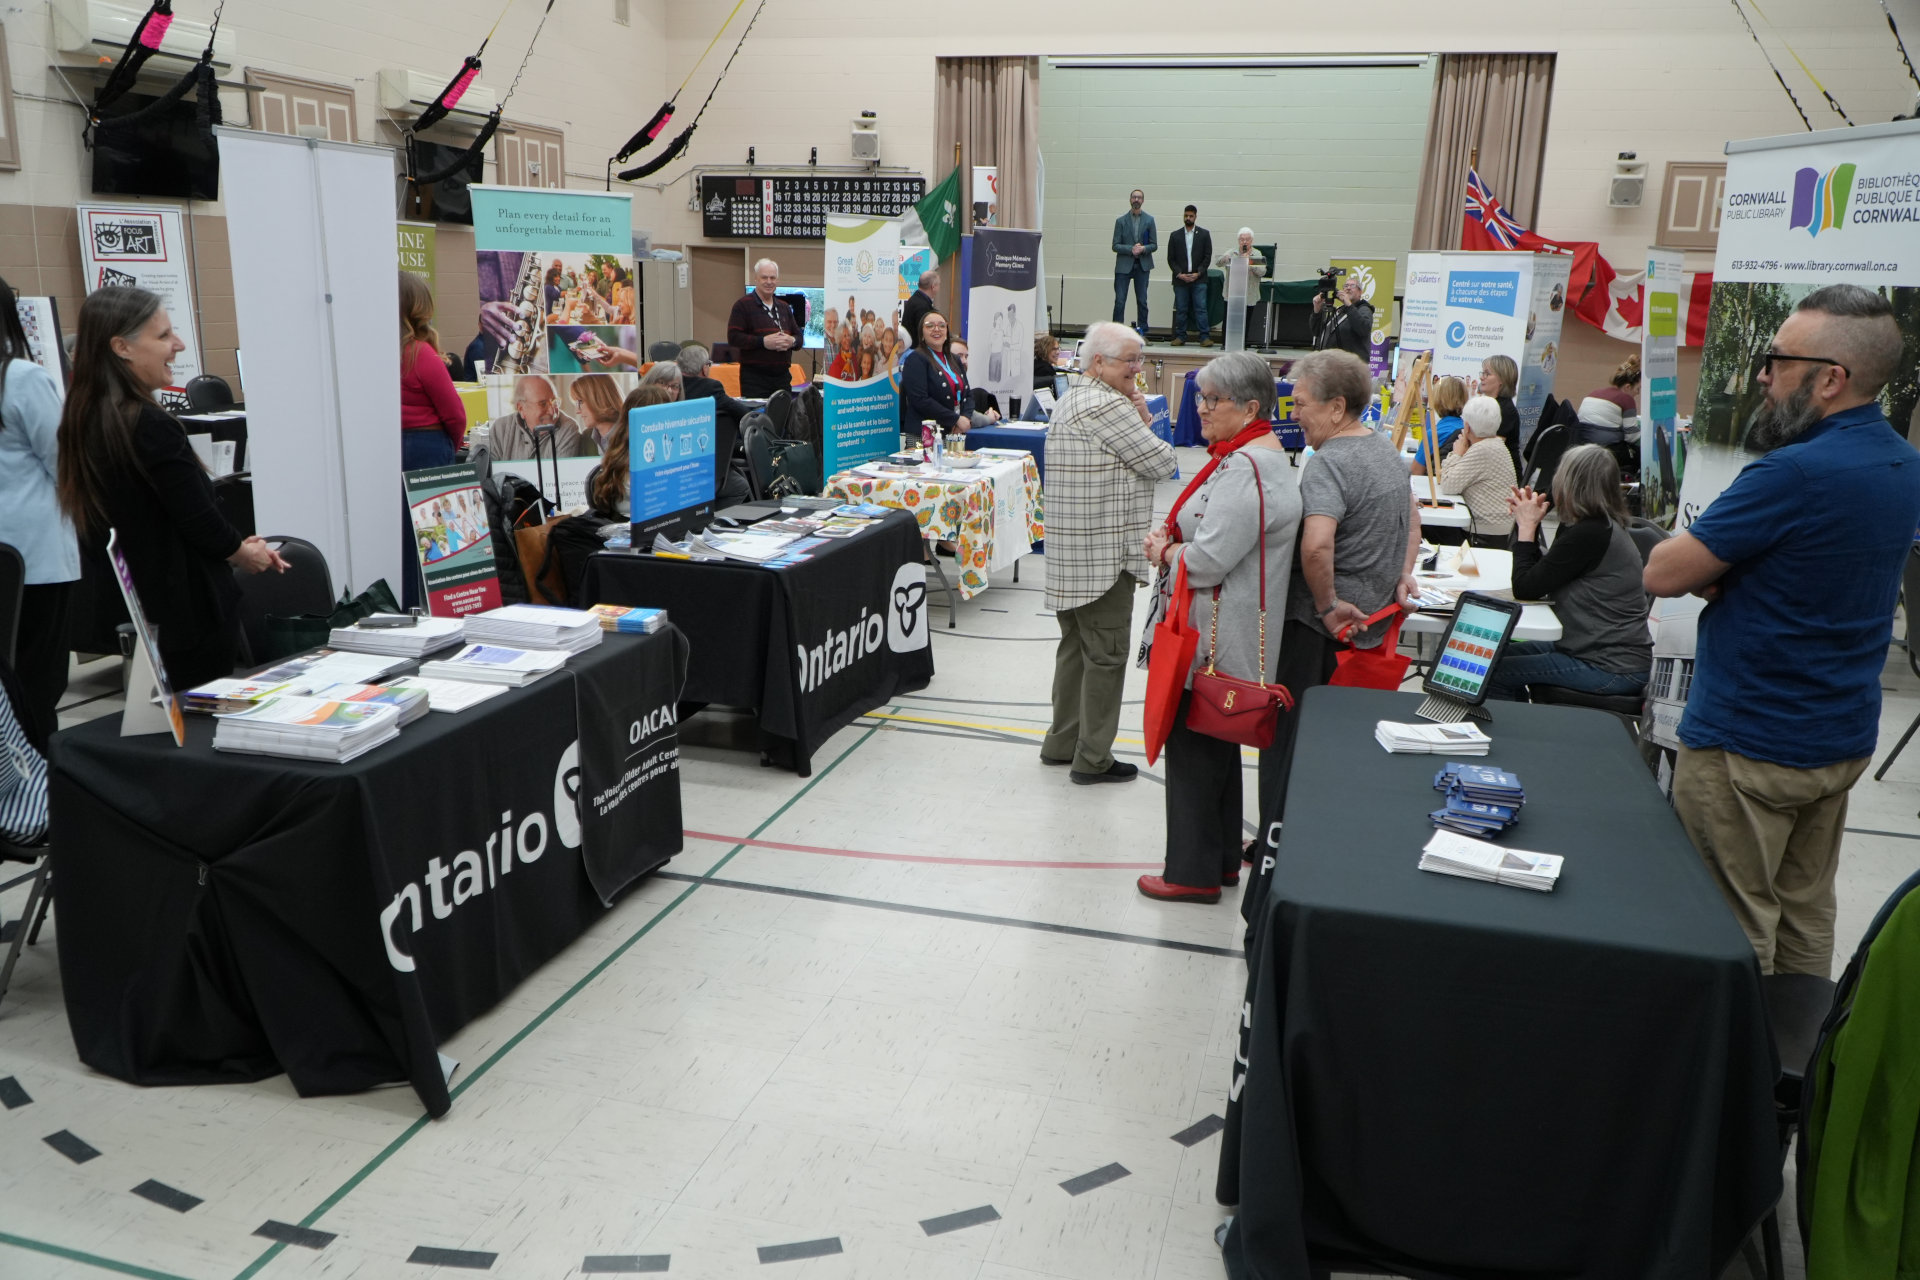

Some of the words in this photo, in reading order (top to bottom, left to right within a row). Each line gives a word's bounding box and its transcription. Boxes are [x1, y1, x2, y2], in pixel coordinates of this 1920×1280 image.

[776, 181, 779, 189] 1
[785, 181, 789, 190] 2
[795, 181, 799, 190] 3
[804, 181, 809, 190] 4
[814, 181, 818, 190] 5
[823, 181, 828, 190] 6
[834, 181, 838, 190] 7
[844, 181, 849, 190] 8
[854, 181, 859, 191] 9
[863, 182, 870, 191] 10
[873, 182, 880, 191] 11
[883, 182, 890, 191] 12
[893, 182, 900, 191] 13
[902, 182, 910, 191] 14
[912, 182, 920, 191] 15
[1857, 172, 1920, 190] BIBLIOTHÈQ
[774, 192, 782, 201] 16
[784, 192, 791, 201] 17
[793, 192, 801, 201] 18
[803, 192, 810, 201] 19
[812, 192, 820, 202] 20
[822, 192, 830, 202] 21
[831, 193, 840, 202] 22
[842, 192, 851, 202] 23
[852, 192, 861, 202] 24
[862, 193, 871, 202] 25
[872, 193, 881, 202] 26
[882, 193, 890, 202] 27
[892, 193, 901, 203] 28
[902, 193, 910, 203] 29
[912, 193, 920, 203] 30
[1729, 191, 1786, 206] CORNWALL
[1855, 190, 1913, 205] PUBLIQUE
[774, 203, 782, 212] 31
[783, 203, 792, 213] 32
[793, 203, 801, 213] 33
[802, 203, 811, 213] 34
[812, 204, 821, 213] 35
[822, 204, 830, 213] 36
[831, 204, 840, 213] 37
[842, 204, 851, 213] 38
[852, 204, 861, 213] 39
[862, 204, 871, 214] 40
[872, 205, 880, 213] 41
[882, 204, 890, 214] 42
[892, 205, 901, 214] 43
[1727, 209, 1751, 220] PUBLIC
[1752, 208, 1786, 219] LIBRARY
[498, 208, 521, 219] Plan
[523, 212, 549, 223] every
[552, 211, 579, 222] detail
[582, 212, 597, 223] for
[774, 214, 782, 224] 46
[783, 215, 792, 223] 47
[793, 215, 801, 224] 48
[802, 215, 811, 224] 49
[812, 215, 821, 224] 50
[1853, 208, 1920, 224] CORNWAL
[495, 224, 562, 237] unforgettable
[565, 228, 615, 238] memorial.
[774, 226, 782, 235] 61
[783, 226, 792, 235] 62
[793, 226, 801, 235] 63
[802, 226, 811, 235] 64
[812, 226, 821, 236] 65
[126, 235, 153, 254] ART
[398, 231, 425, 249] INE
[399, 251, 426, 267] USE
[837, 256, 854, 266] Great
[877, 257, 895, 267] Grand
[995, 254, 1012, 263] Clinique
[995, 262, 1012, 270] Memory
[1731, 260, 1778, 270] 613-932-4796
[1784, 259, 1898, 274] www.library.cornwall.on.ca
[1452, 280, 1470, 288] Centré
[1497, 280, 1514, 289] santé,
[1490, 289, 1509, 297] étapes
[1491, 325, 1504, 333] santé
[837, 398, 852, 406] Where
[852, 395, 877, 404] everyone's
[837, 407, 846, 415] and
[845, 405, 870, 413] well-being
[641, 422, 665, 434] Conduite
[665, 418, 687, 429] hivernale
[688, 415, 711, 425] sécuritaire
[853, 419, 866, 427] santé
[853, 429, 870, 437] chaque
[870, 427, 893, 435] personne
[837, 438, 860, 448] comptent!
[629, 701, 678, 745] OACA
[593, 794, 605, 807] The
[624, 766, 640, 783] Older
[641, 755, 658, 772] Adult
[658, 747, 679, 761] Cent
[600, 806, 608, 816] La
[619, 789, 628, 801] des
[627, 773, 649, 793] centres
[650, 763, 668, 779] pour
